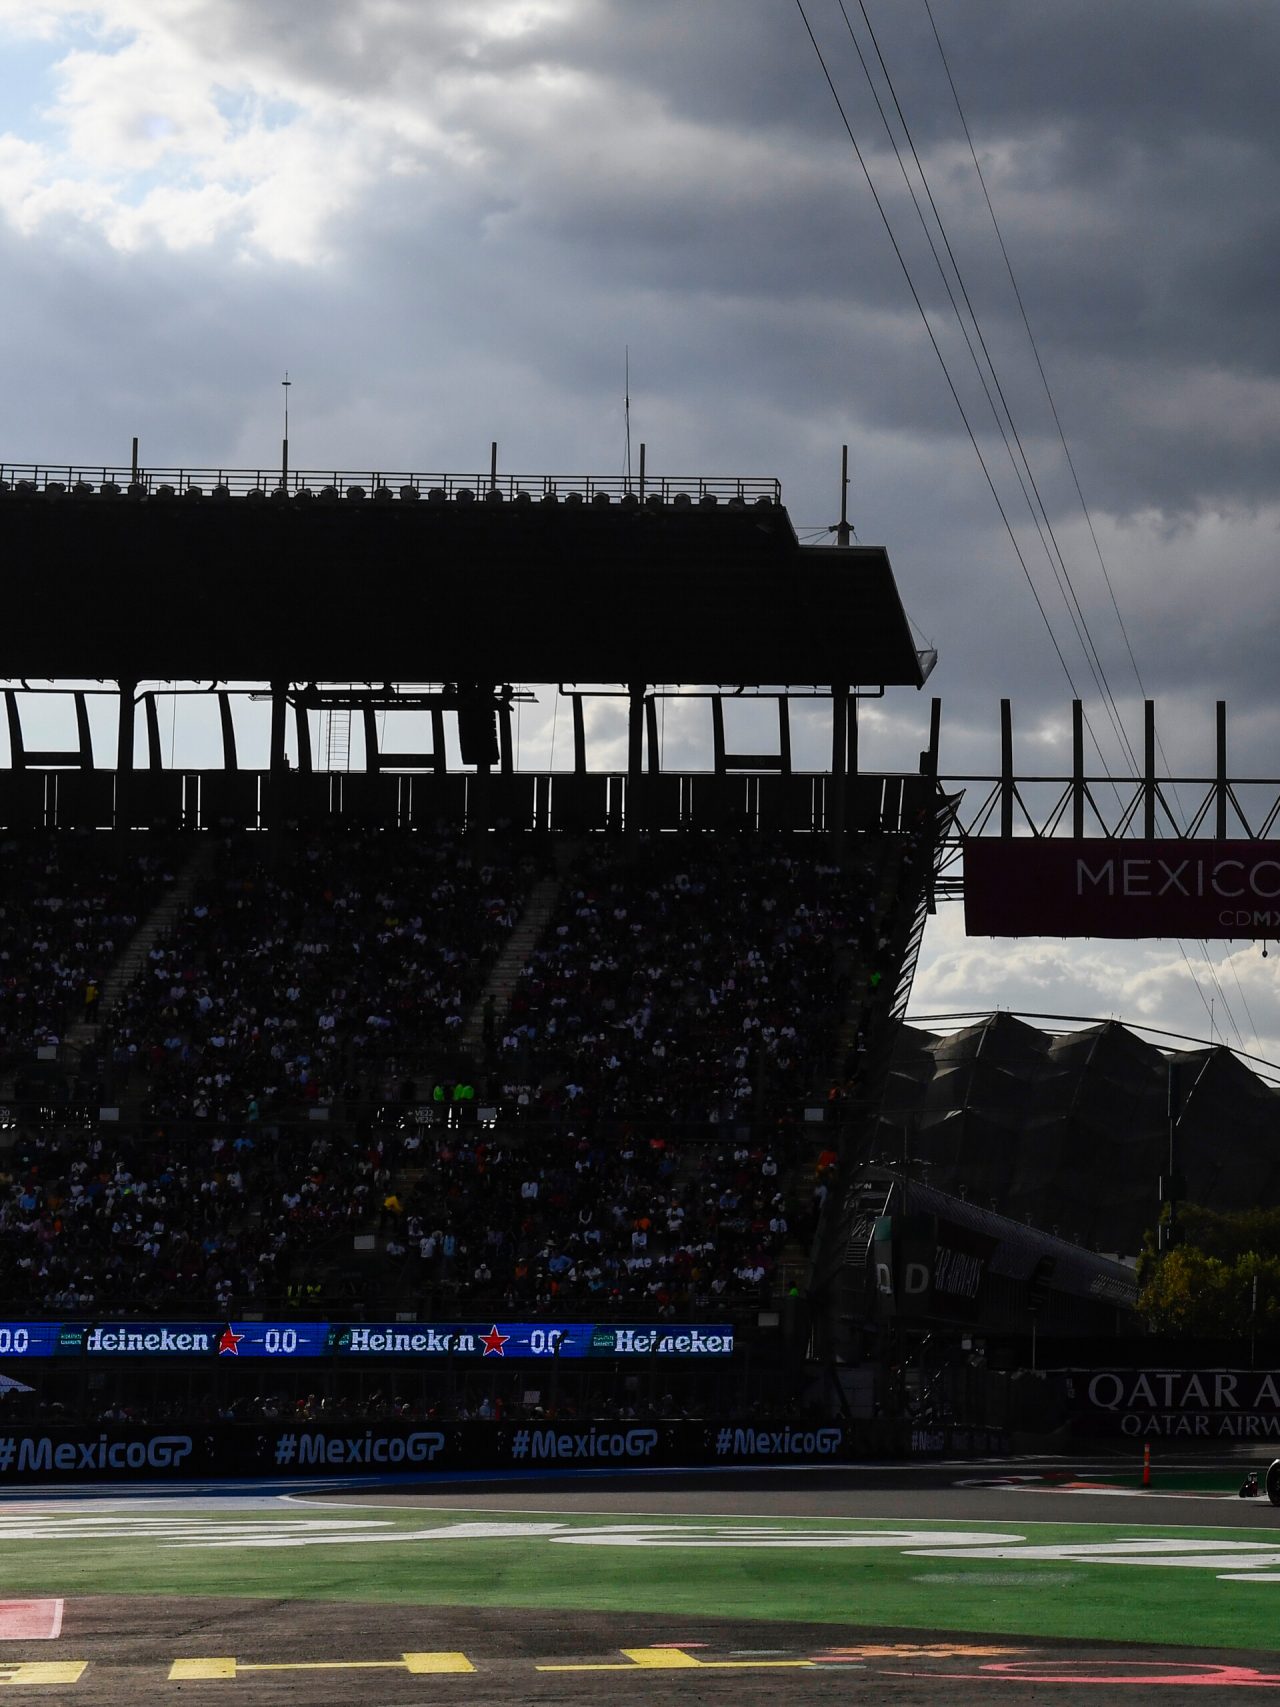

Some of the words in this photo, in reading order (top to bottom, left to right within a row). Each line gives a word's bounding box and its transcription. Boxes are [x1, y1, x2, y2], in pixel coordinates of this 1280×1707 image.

[83, 1328, 210, 1351] Heineken
[265, 1329, 297, 1353] 0.0
[350, 1329, 476, 1351] Heineken
[1087, 1373, 1239, 1411] QATAR
[511, 1426, 658, 1459] #MexicoGP
[716, 1425, 842, 1456] #MexicoGP
[1120, 1414, 1210, 1440] QATAR
[0, 1433, 193, 1472] #MexicoGP
[275, 1430, 446, 1464] #MexicoGP
